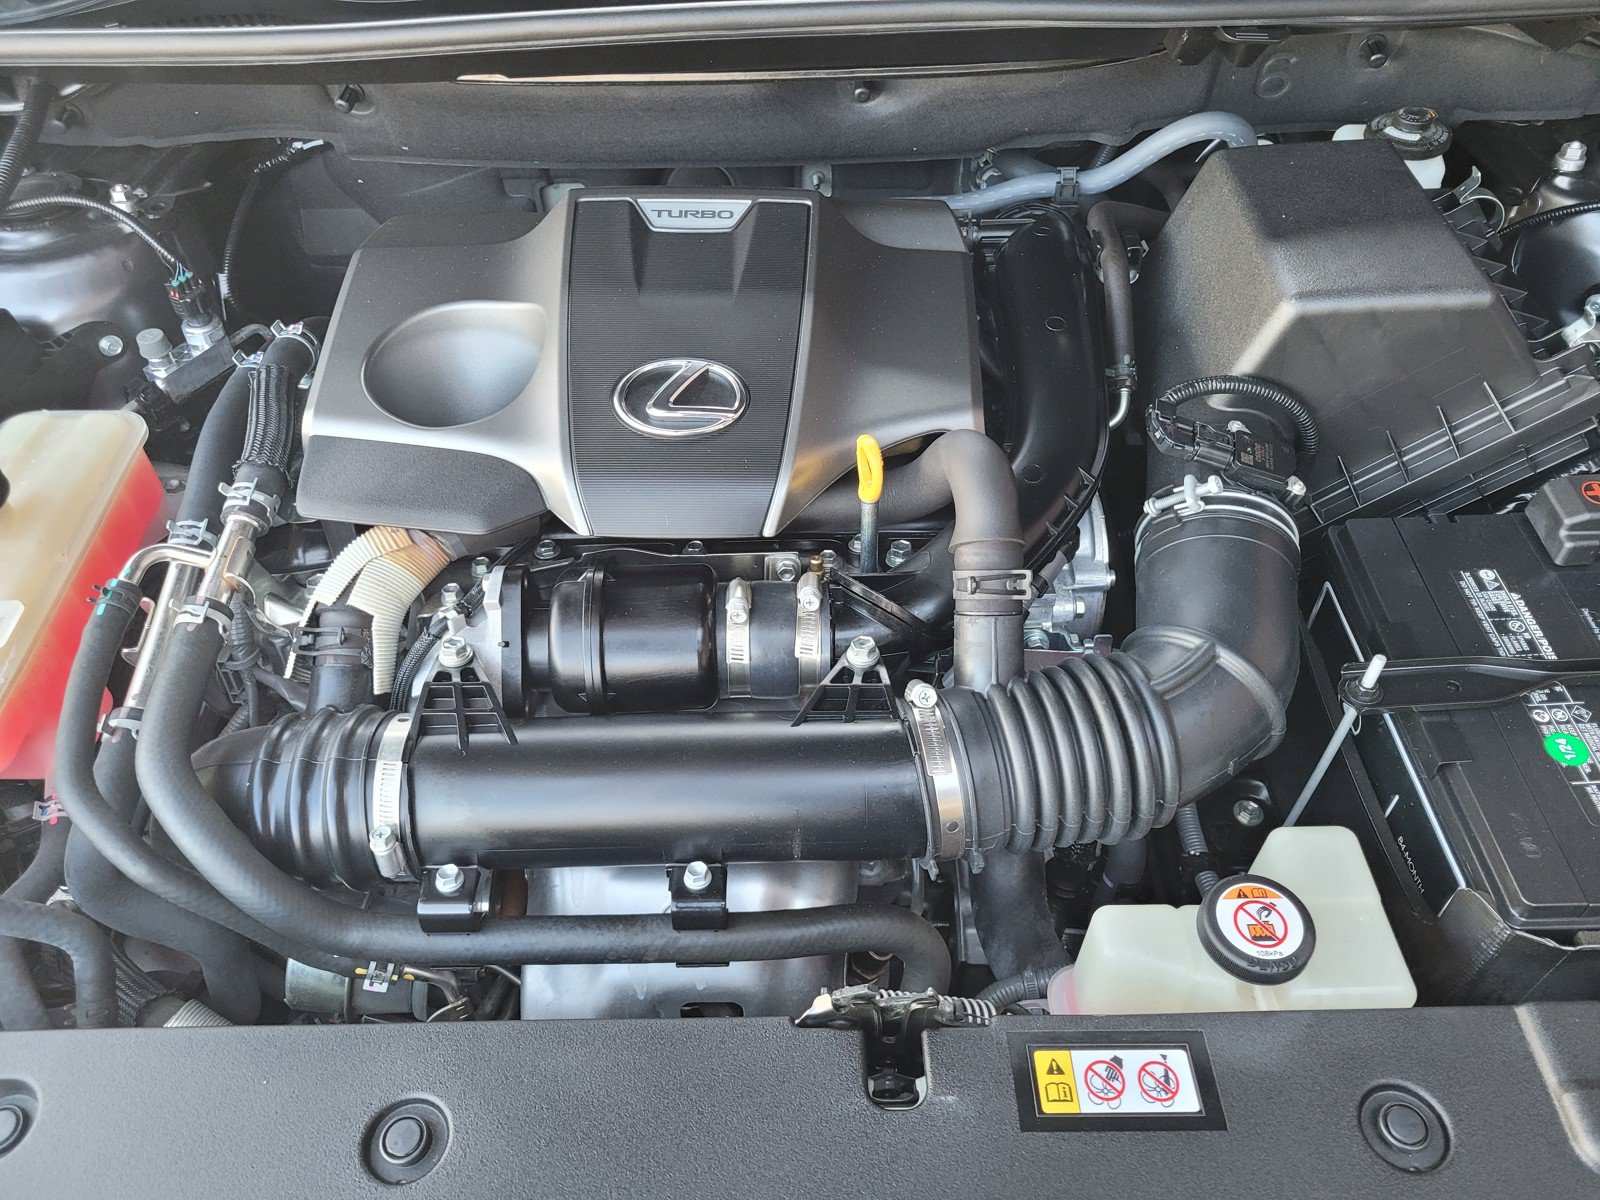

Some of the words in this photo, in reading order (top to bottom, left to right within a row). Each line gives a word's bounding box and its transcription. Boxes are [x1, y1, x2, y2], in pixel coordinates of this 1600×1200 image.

[1254, 53, 1298, 98] 6
[650, 209, 735, 219] TURBO
[1516, 600, 1557, 659] DANGER/POIS
[1555, 739, 1576, 760] 1/24
[1398, 836, 1425, 894] 84-MONTH
